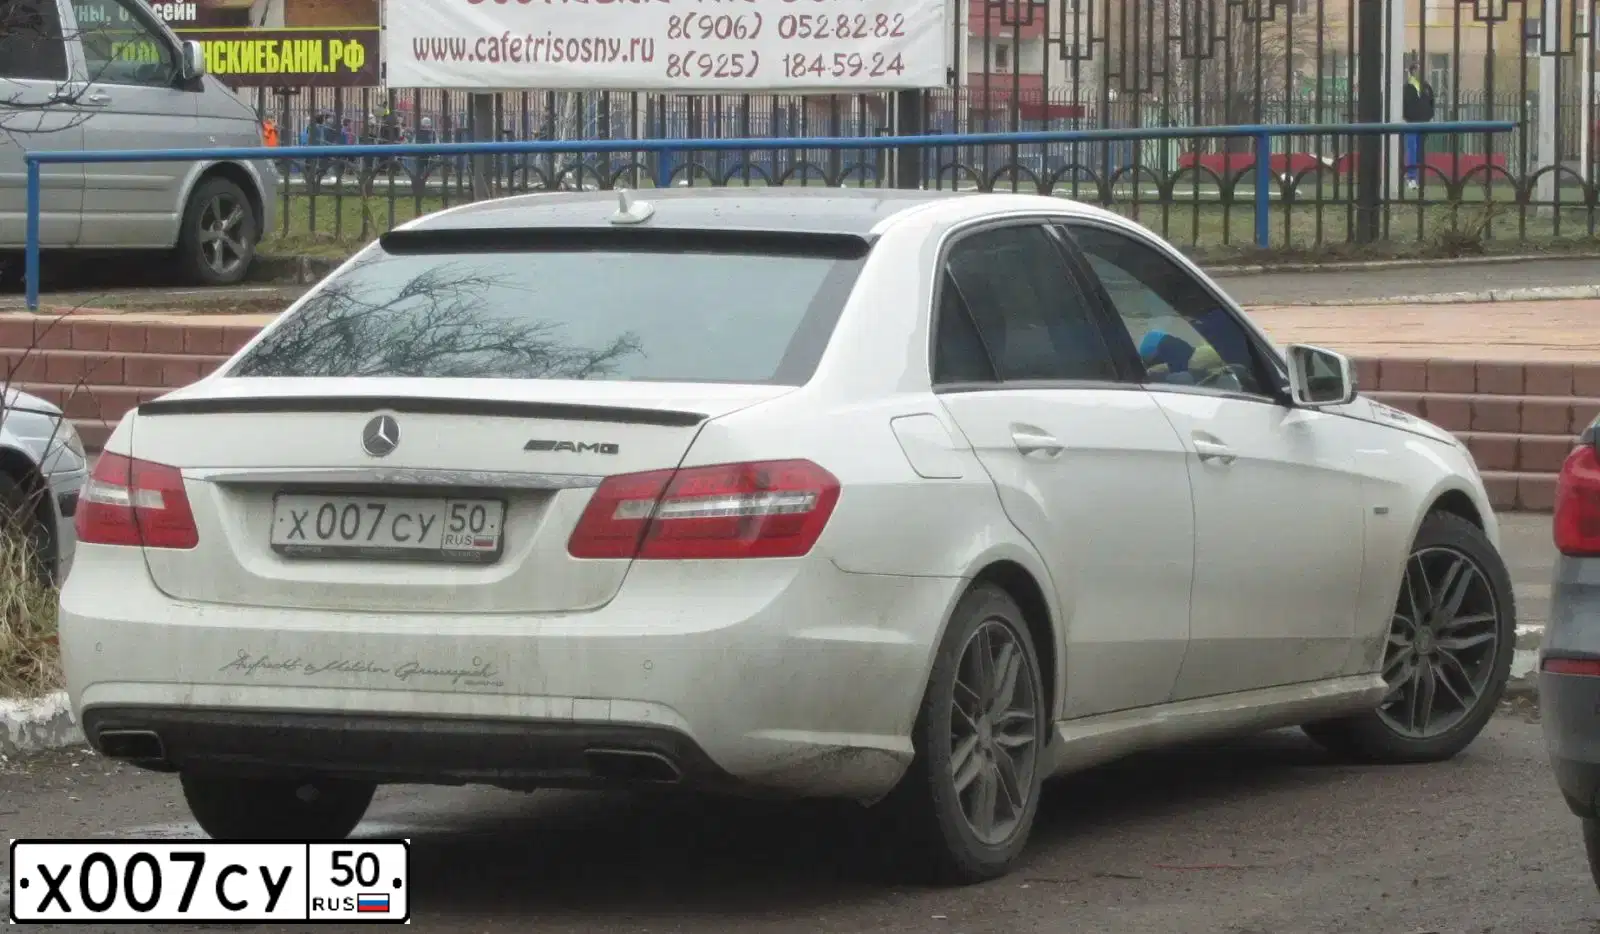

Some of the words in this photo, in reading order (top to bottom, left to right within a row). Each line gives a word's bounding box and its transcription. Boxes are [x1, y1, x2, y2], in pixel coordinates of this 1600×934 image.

[667, 12, 762, 40] 8(906)
[413, 31, 654, 64] www.cafetrisosny.ru
[666, 50, 759, 78] 8(925)
[450, 504, 486, 533] 50
[445, 534, 473, 546] RUS
